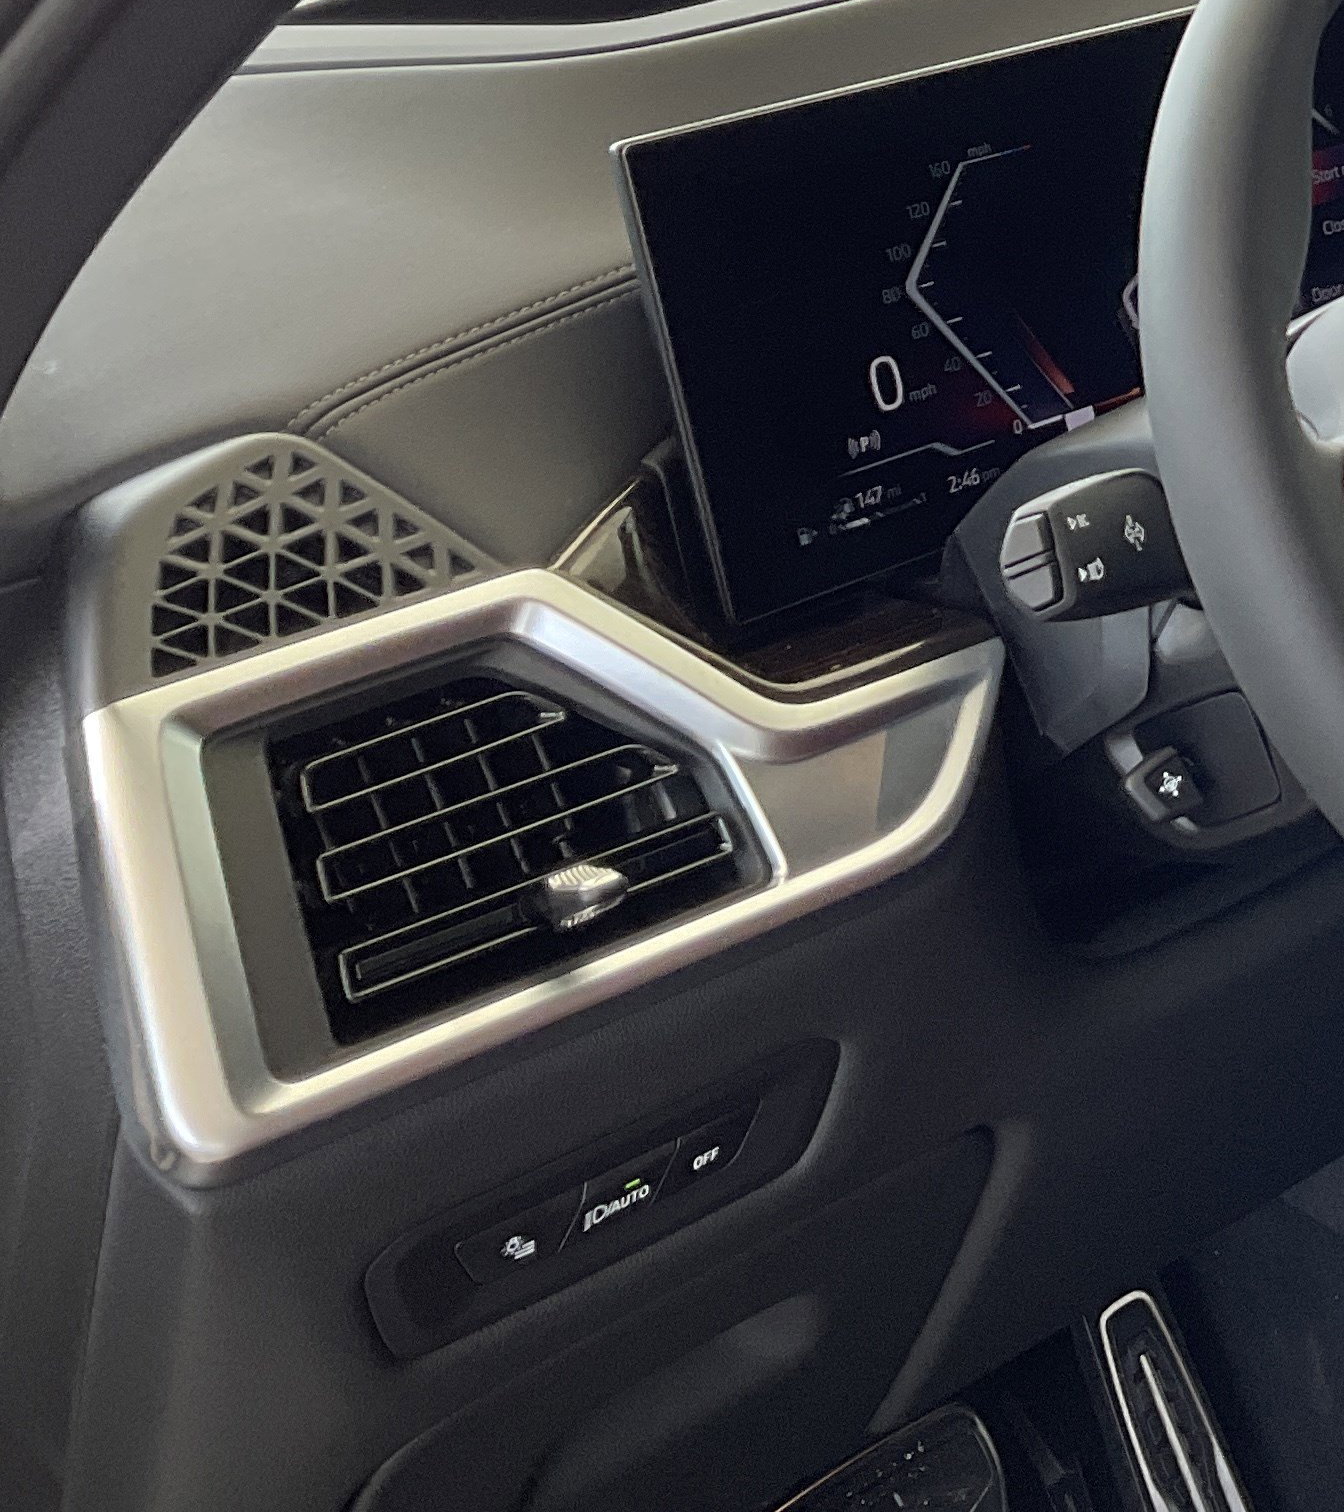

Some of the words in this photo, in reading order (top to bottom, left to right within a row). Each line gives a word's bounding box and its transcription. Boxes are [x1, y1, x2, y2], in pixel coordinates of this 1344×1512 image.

[967, 142, 993, 158] mph
[906, 201, 930, 220] 120
[885, 243, 912, 263] 100
[882, 286, 901, 304] 80
[911, 321, 930, 339] 60
[944, 356, 962, 372] 40
[870, 355, 903, 411] 0
[909, 383, 937, 402] mph
[974, 390, 993, 407] 20
[1013, 419, 1023, 435] 0
[947, 467, 981, 493] 2:46
[854, 485, 883, 508] 147
[693, 1146, 720, 1170] OFF
